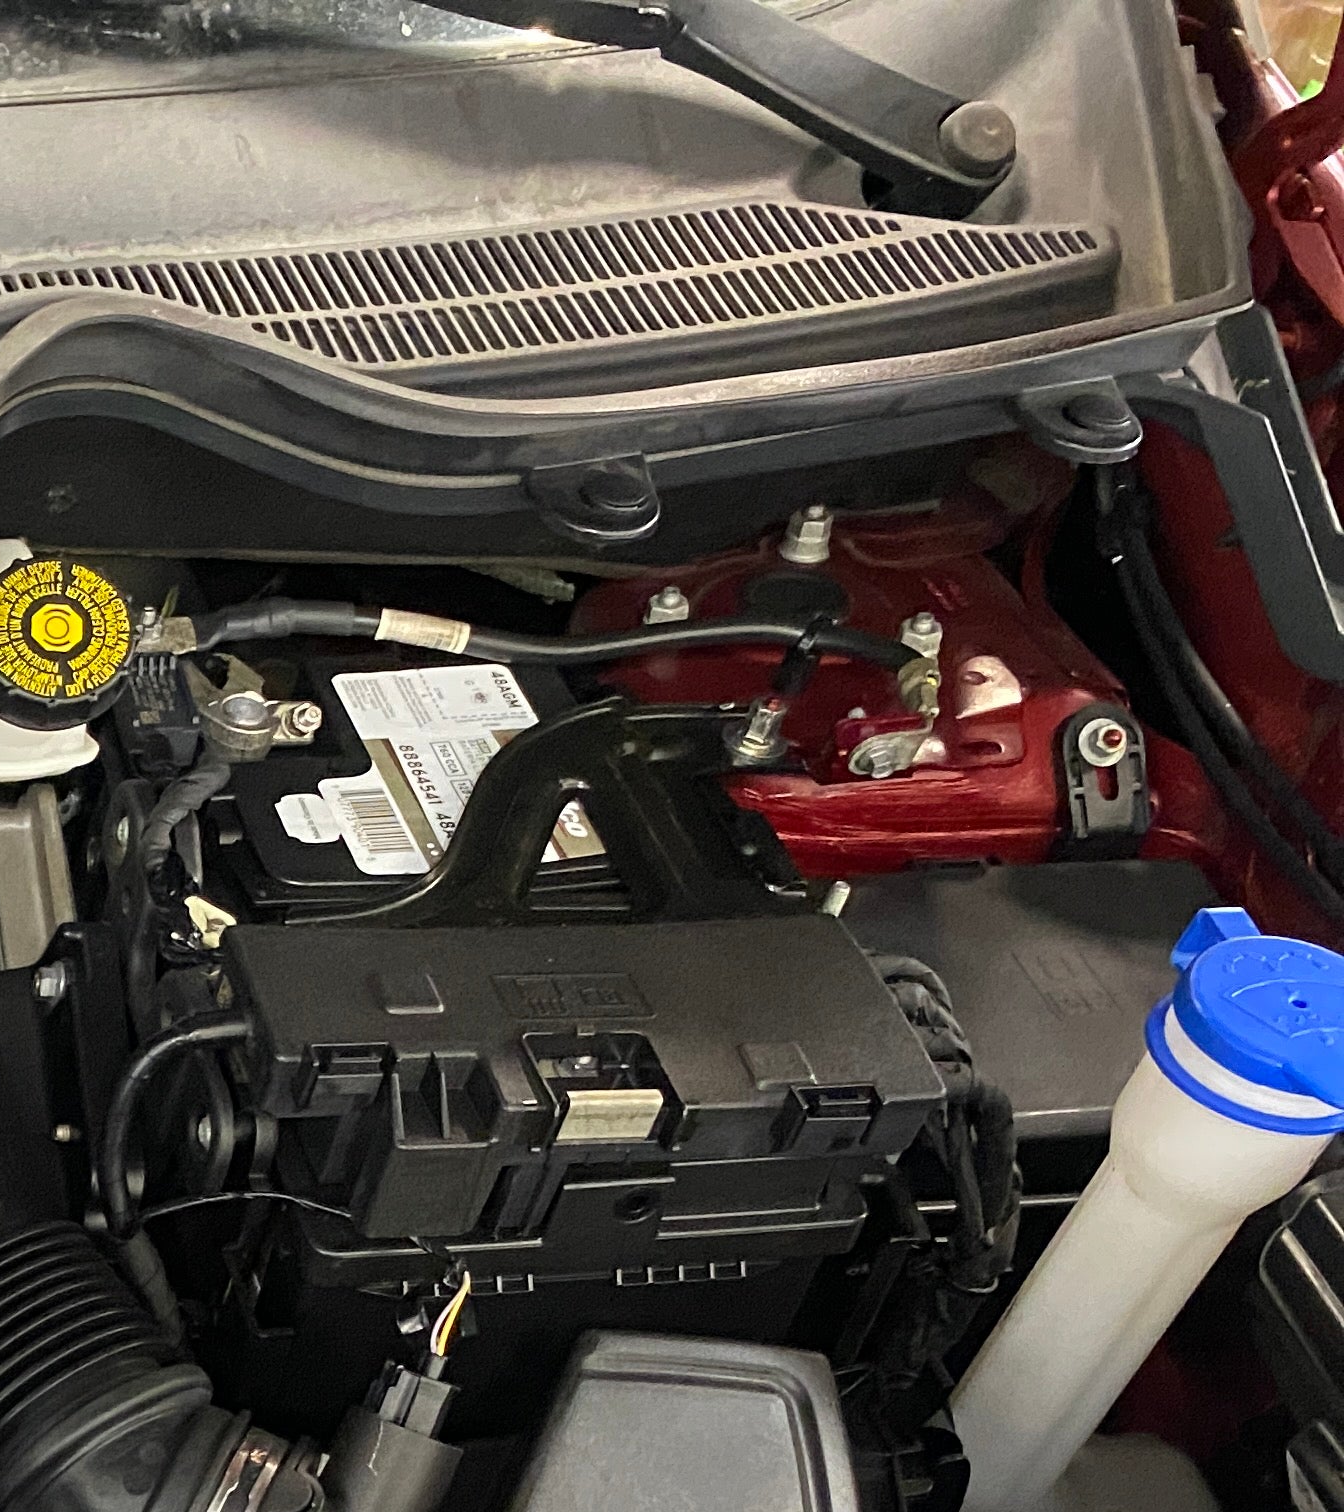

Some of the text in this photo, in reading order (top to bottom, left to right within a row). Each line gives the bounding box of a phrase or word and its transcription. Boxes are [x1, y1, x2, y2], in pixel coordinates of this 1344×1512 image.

[4, 588, 19, 602] DE
[57, 570, 63, 581] 4
[109, 596, 129, 631] SEALED
[64, 585, 104, 672] WARNING CLEAN FILLER
[117, 632, 129, 640] A
[12, 639, 58, 672] PROVENANT
[108, 640, 129, 667] FROM
[8, 671, 56, 696] ATTENTION
[83, 678, 94, 690] 4
[90, 662, 116, 686] FLUID
[65, 681, 86, 697] DOT
[489, 668, 522, 710] 48AGM
[398, 743, 444, 804] 88864541
[445, 758, 460, 775] CCA
